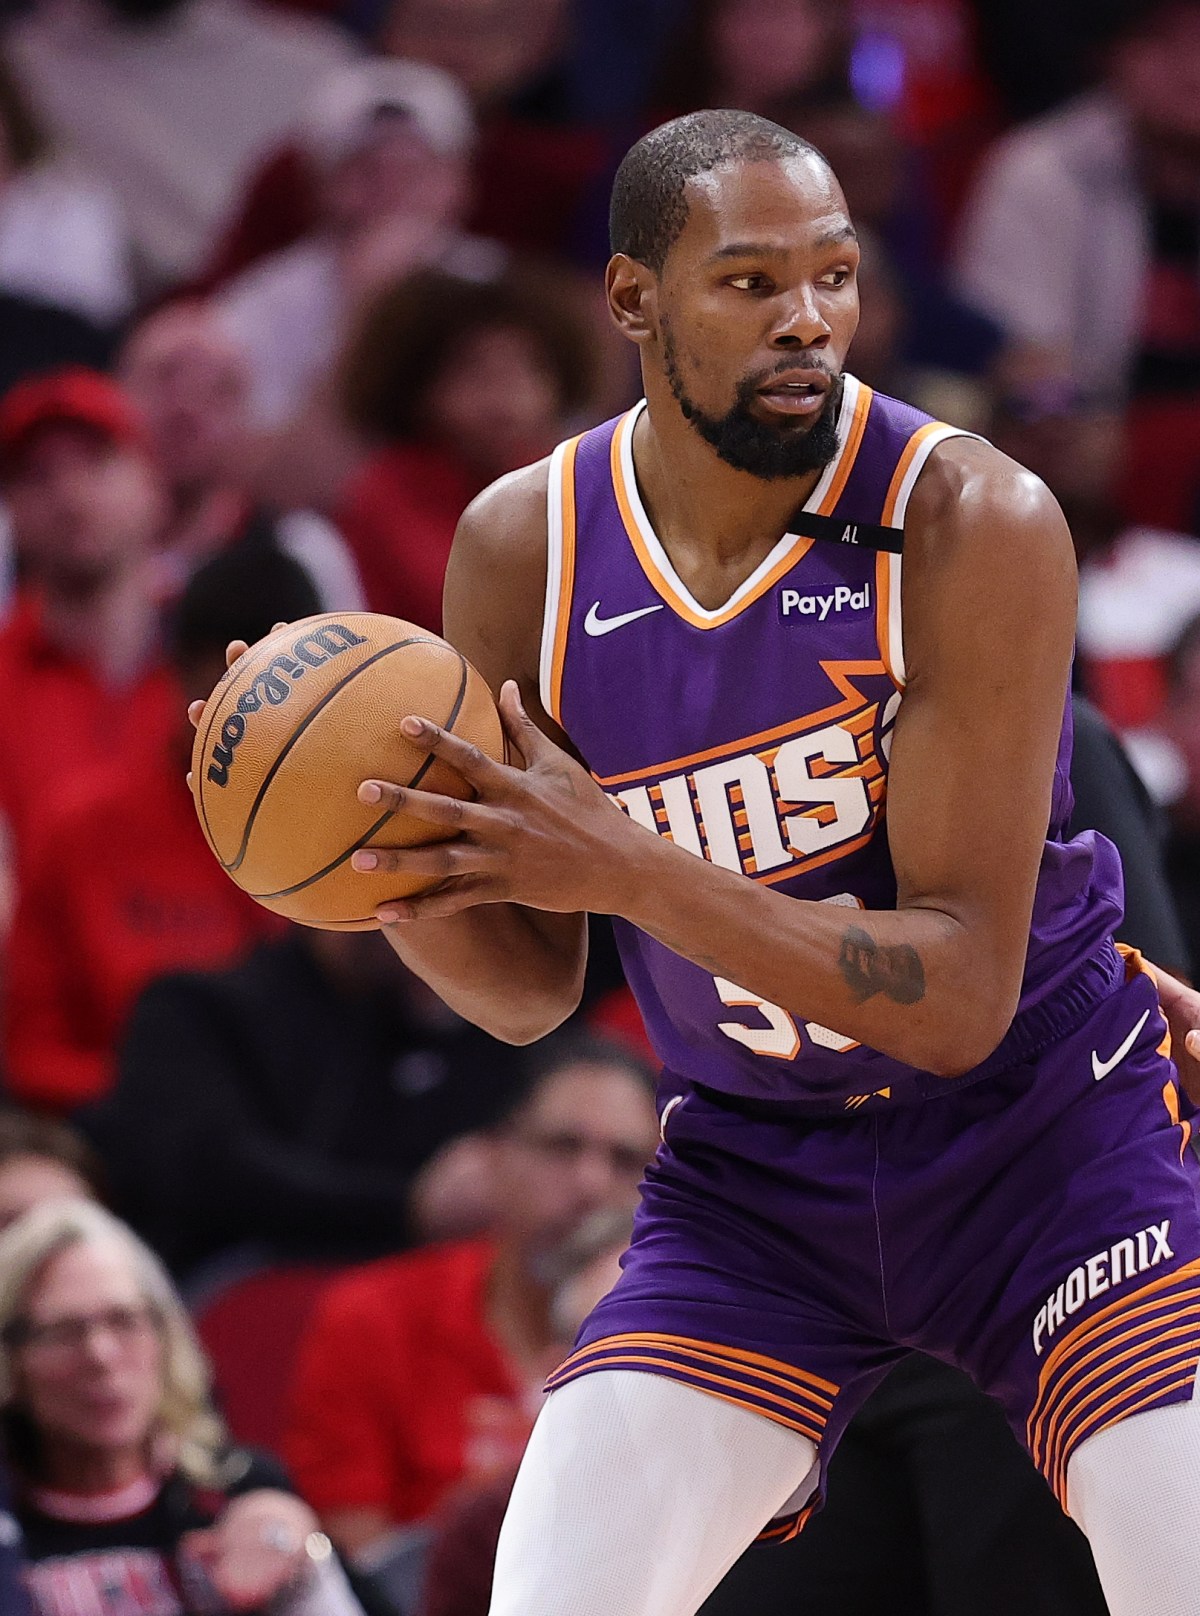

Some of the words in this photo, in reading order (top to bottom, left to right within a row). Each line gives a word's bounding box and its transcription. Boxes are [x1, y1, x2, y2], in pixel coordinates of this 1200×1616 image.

[781, 582, 870, 621] PayPal
[841, 524, 859, 544] AL
[207, 622, 369, 788] Wilson
[604, 725, 871, 873] UNS
[1032, 1219, 1175, 1357] PHOENIX
